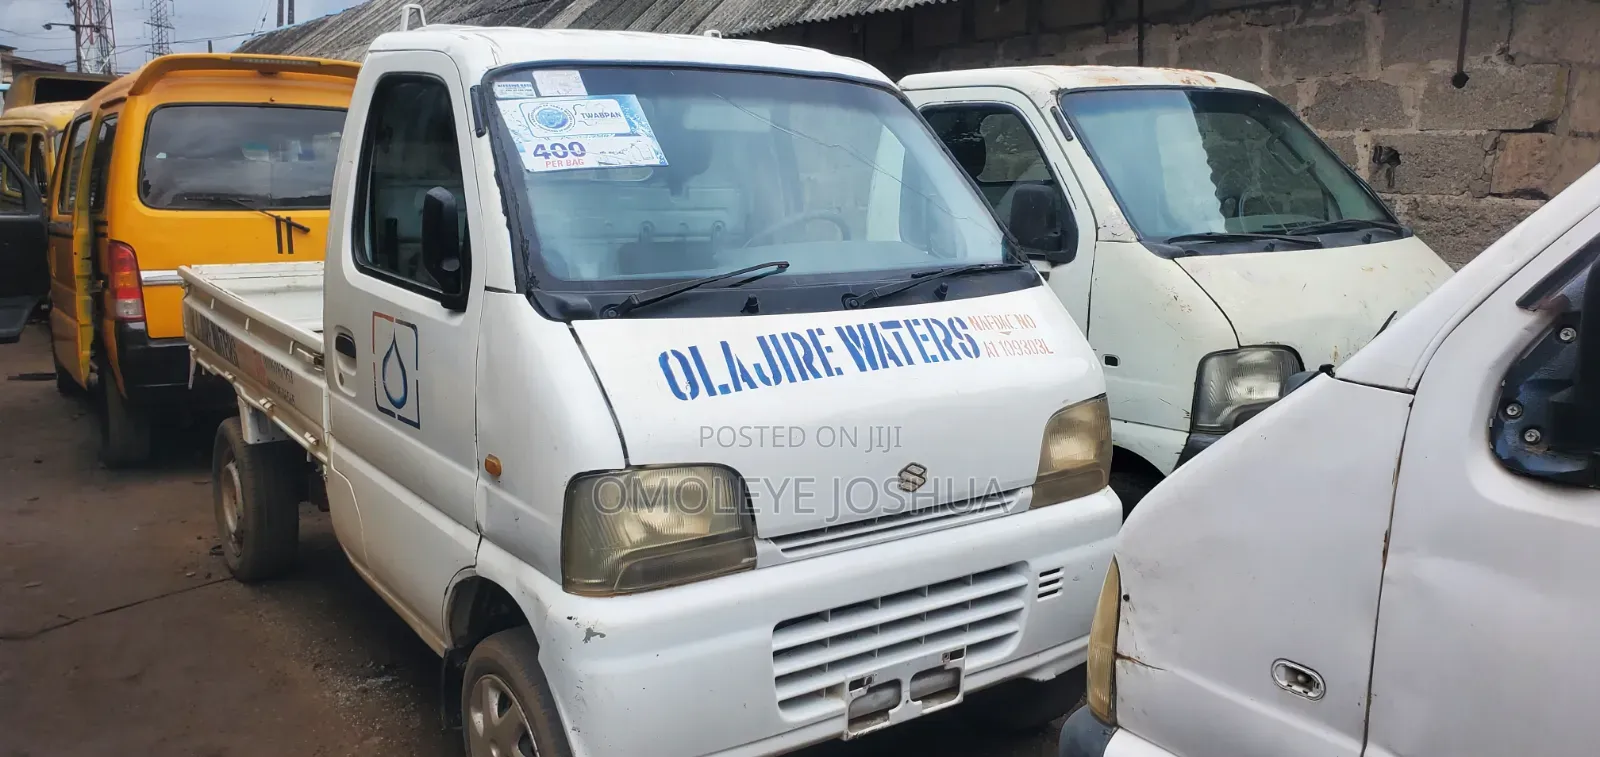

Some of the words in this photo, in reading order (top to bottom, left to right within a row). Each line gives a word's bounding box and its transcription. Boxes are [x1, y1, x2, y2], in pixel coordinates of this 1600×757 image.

[580, 111, 622, 119] TWABPAN
[533, 141, 586, 160] 400
[545, 159, 563, 168] PER
[566, 158, 585, 167] BAG
[968, 314, 1017, 331] NAFDAC
[1014, 313, 1037, 329] NO
[658, 326, 844, 401] OLAJIRE
[834, 316, 981, 373] WATERS
